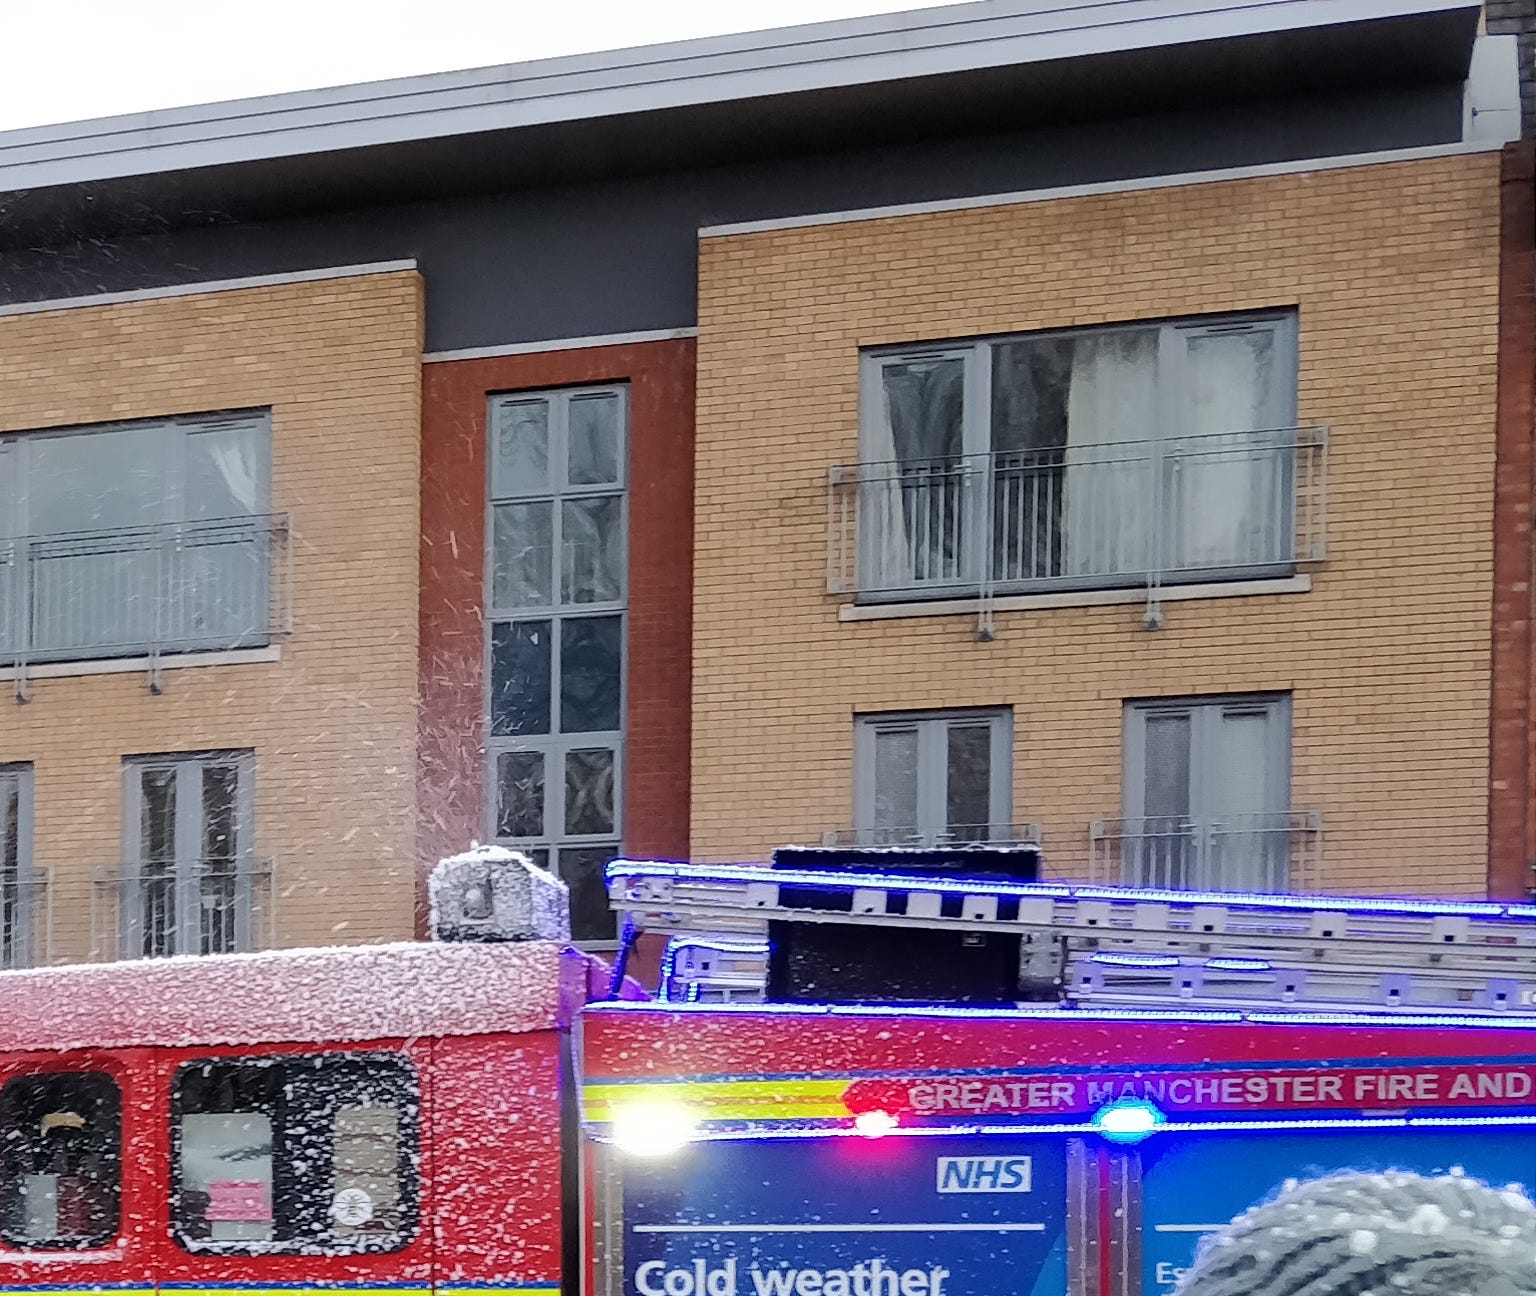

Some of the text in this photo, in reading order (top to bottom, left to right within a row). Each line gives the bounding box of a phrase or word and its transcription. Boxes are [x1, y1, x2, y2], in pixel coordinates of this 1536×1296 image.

[908, 1072, 1532, 1110] GREATER MANCHESTER FIRE AND
[942, 1160, 1027, 1190] NHS
